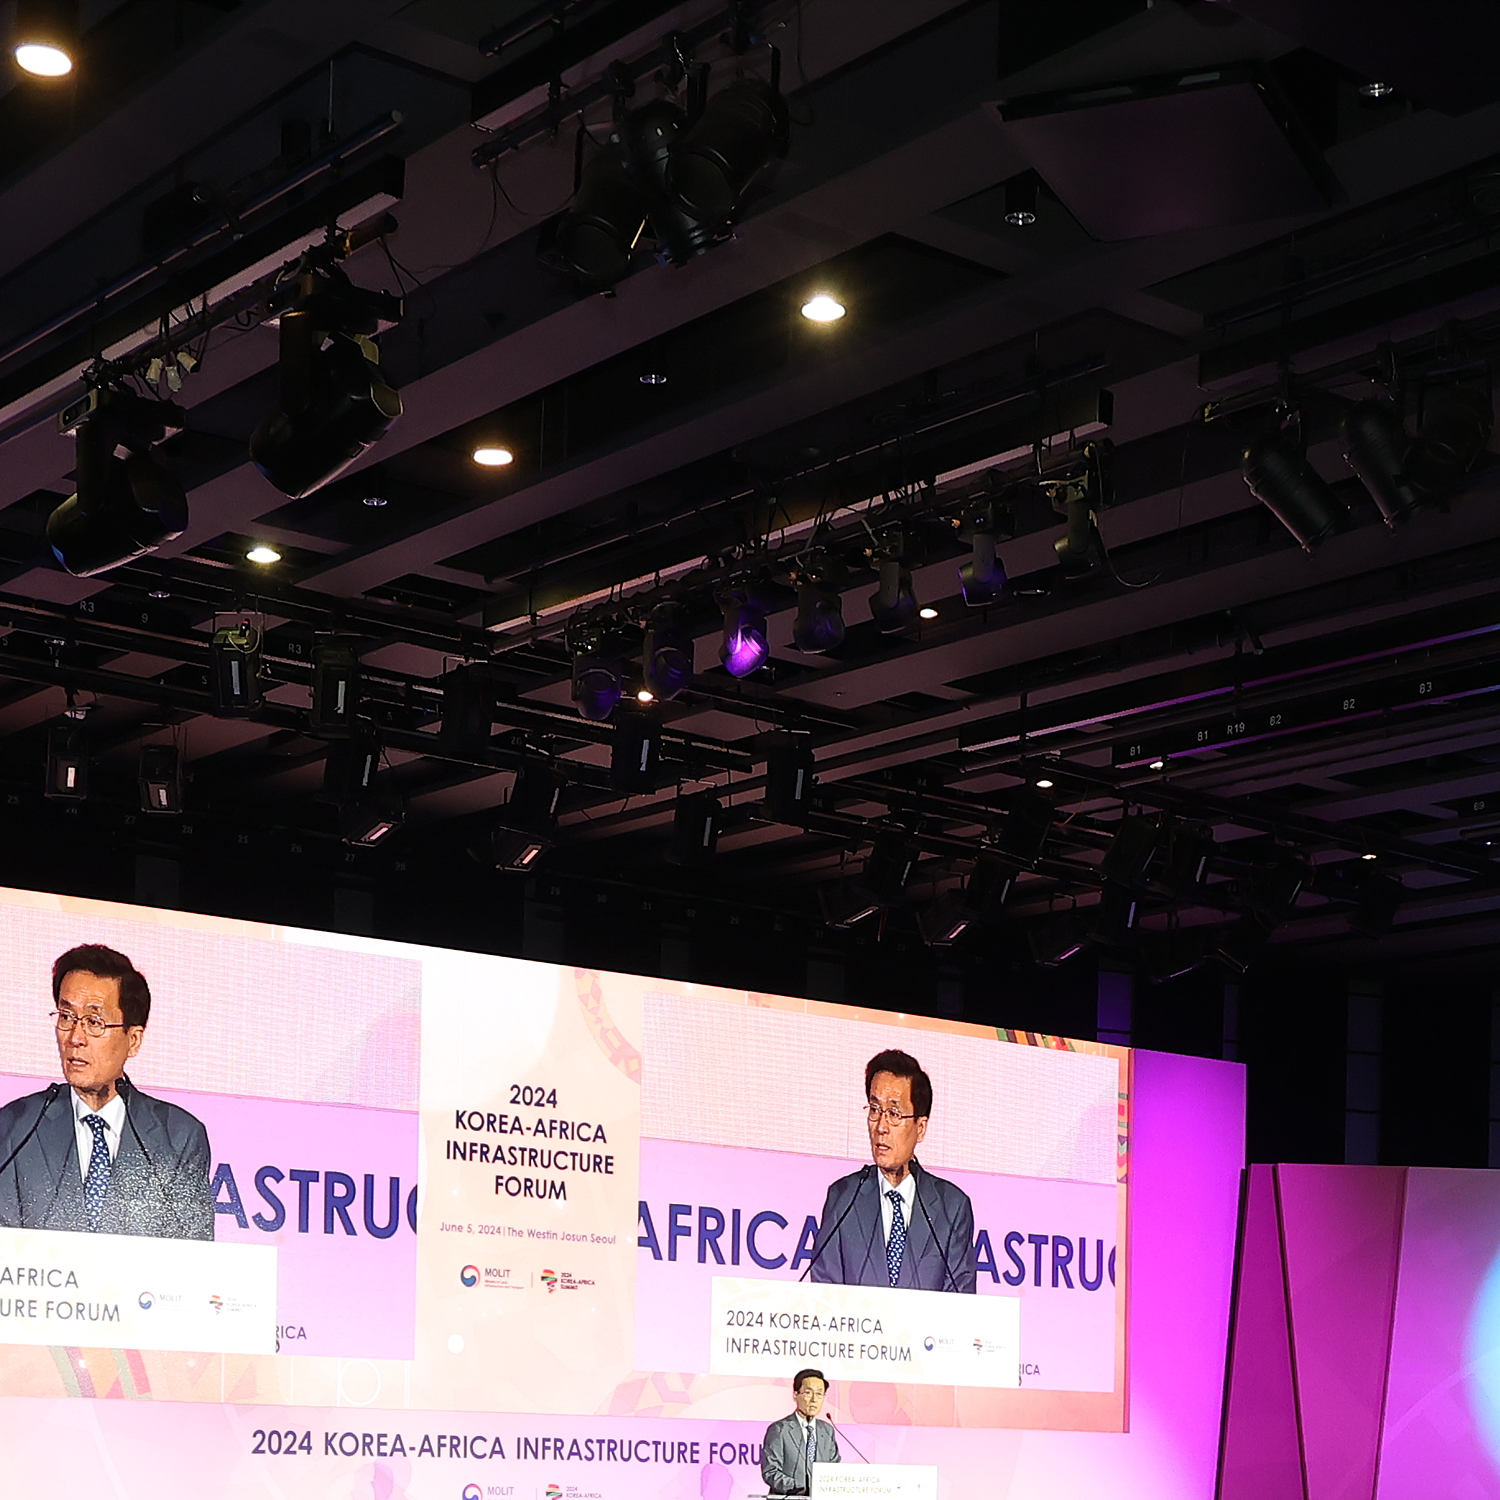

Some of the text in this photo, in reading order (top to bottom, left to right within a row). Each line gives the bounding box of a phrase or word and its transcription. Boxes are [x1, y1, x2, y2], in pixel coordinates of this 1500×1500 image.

[510, 1084, 557, 1109] 2024
[455, 1109, 607, 1143] KOREA-AFRICA
[446, 1140, 614, 1174] INFRASTRUCTURE
[495, 1175, 567, 1200] FORUM
[440, 1222, 464, 1233] June
[466, 1224, 475, 1235] 5,
[507, 1227, 524, 1238] The
[527, 1229, 558, 1240] Westin
[560, 1231, 588, 1242] Josun
[590, 1233, 616, 1244] Seoul
[638, 1200, 820, 1270] AFRICA
[484, 1268, 511, 1278] MOLIT
[46, 1300, 120, 1322] FORUM
[726, 1310, 883, 1334] 2024 KOREA-AFRICA
[726, 1337, 912, 1362] INFRASTRUCTURE FORUM
[251, 1430, 762, 1465] 2024 KOREA-AFRICA INFRASTRUCTURE FORU
[487, 1486, 514, 1496] MOLIT
